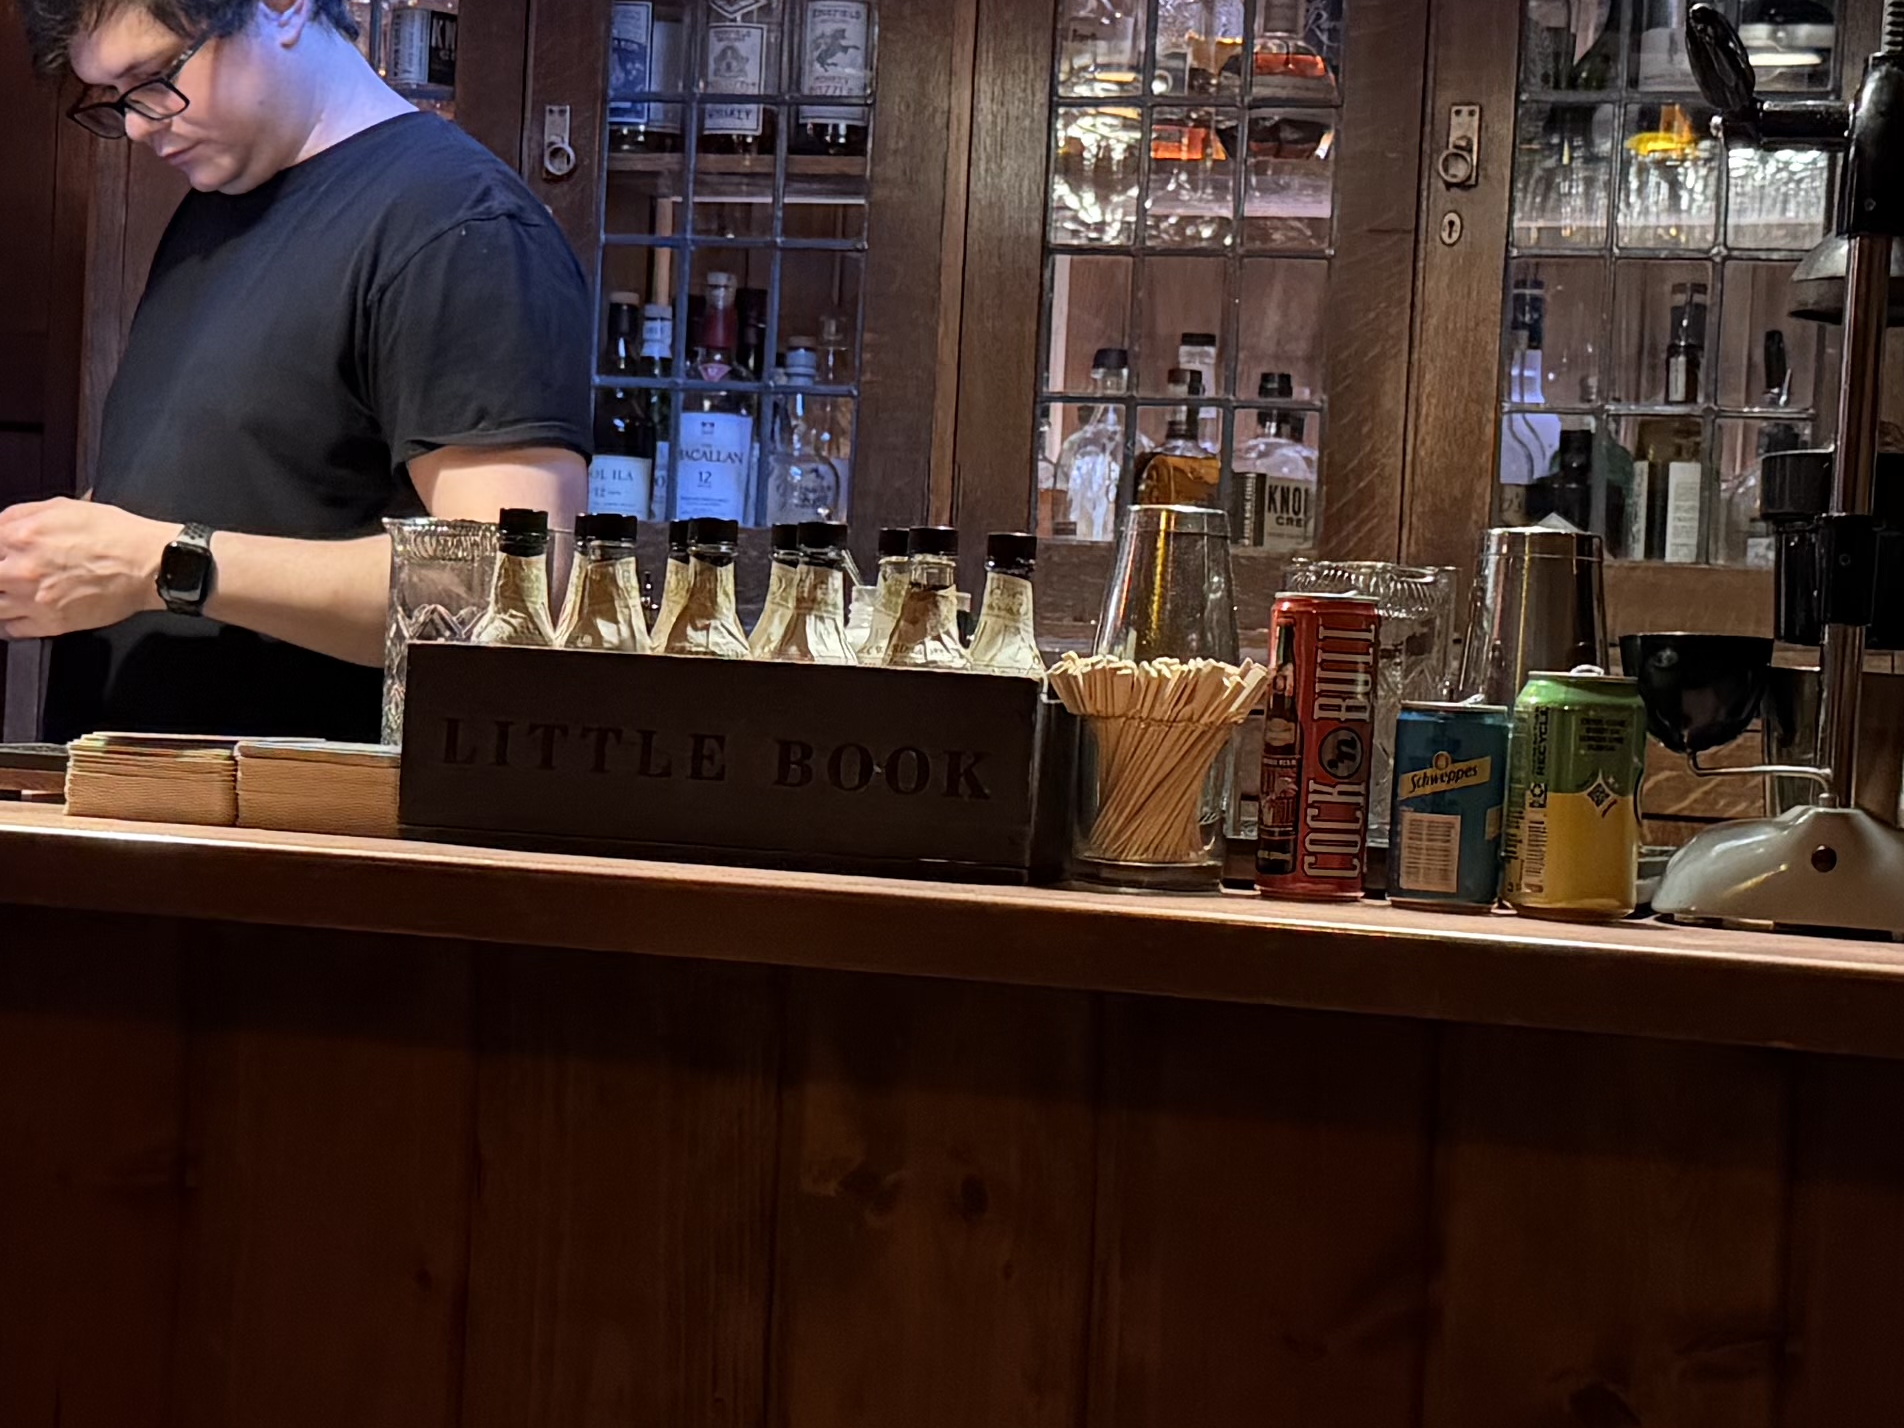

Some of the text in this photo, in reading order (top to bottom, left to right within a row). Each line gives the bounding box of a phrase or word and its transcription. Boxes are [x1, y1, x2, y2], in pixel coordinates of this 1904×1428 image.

[698, 471, 713, 485] 12
[1312, 623, 1377, 723] BULL
[442, 716, 992, 801] LITTLE BOOK
[1409, 767, 1478, 793] Schweppes
[1301, 778, 1367, 879] COCK
